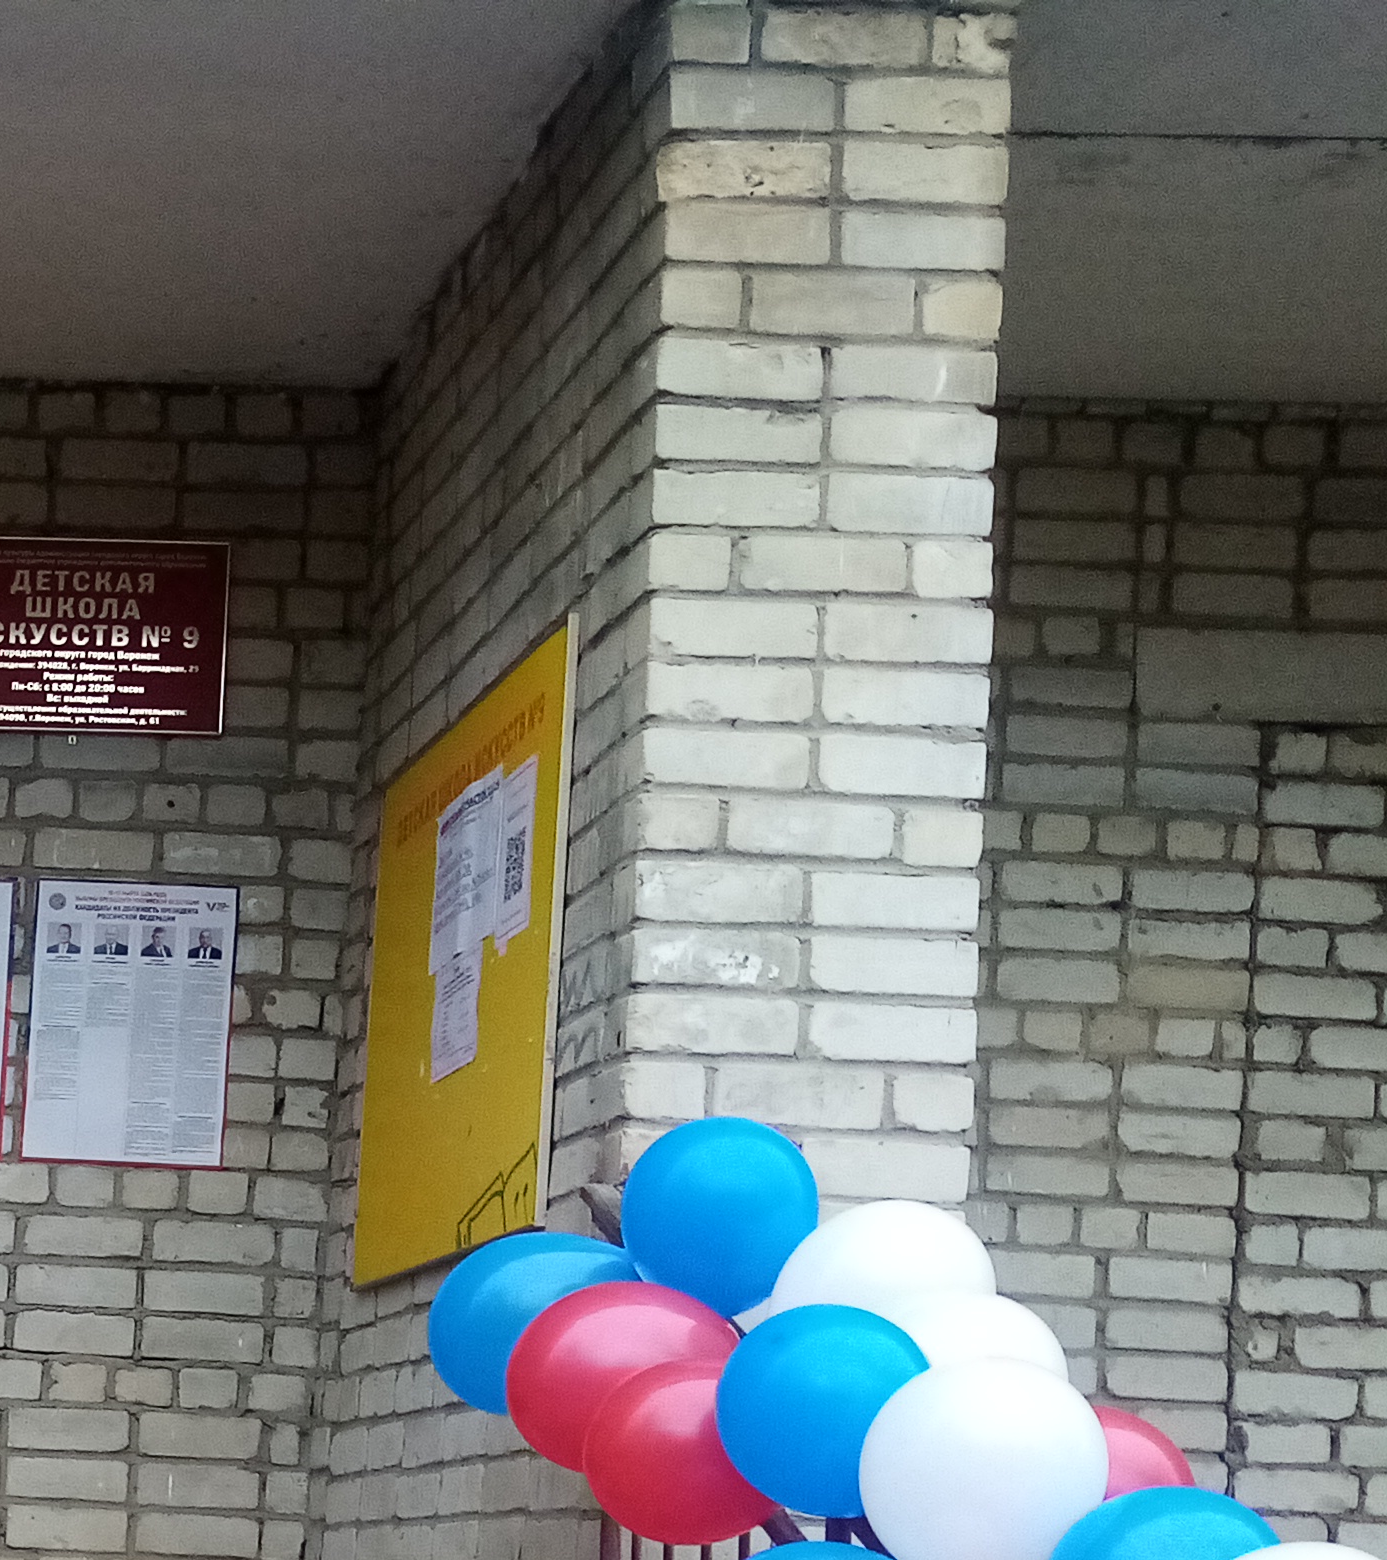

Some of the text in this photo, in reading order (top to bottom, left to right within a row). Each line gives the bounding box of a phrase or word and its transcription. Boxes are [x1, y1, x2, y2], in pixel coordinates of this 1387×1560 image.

[10, 569, 155, 595] ДЕТСКАЯ
[25, 597, 141, 620] ШКОЛА
[141, 625, 172, 648] №
[182, 626, 200, 649] 9
[87, 651, 115, 660] город
